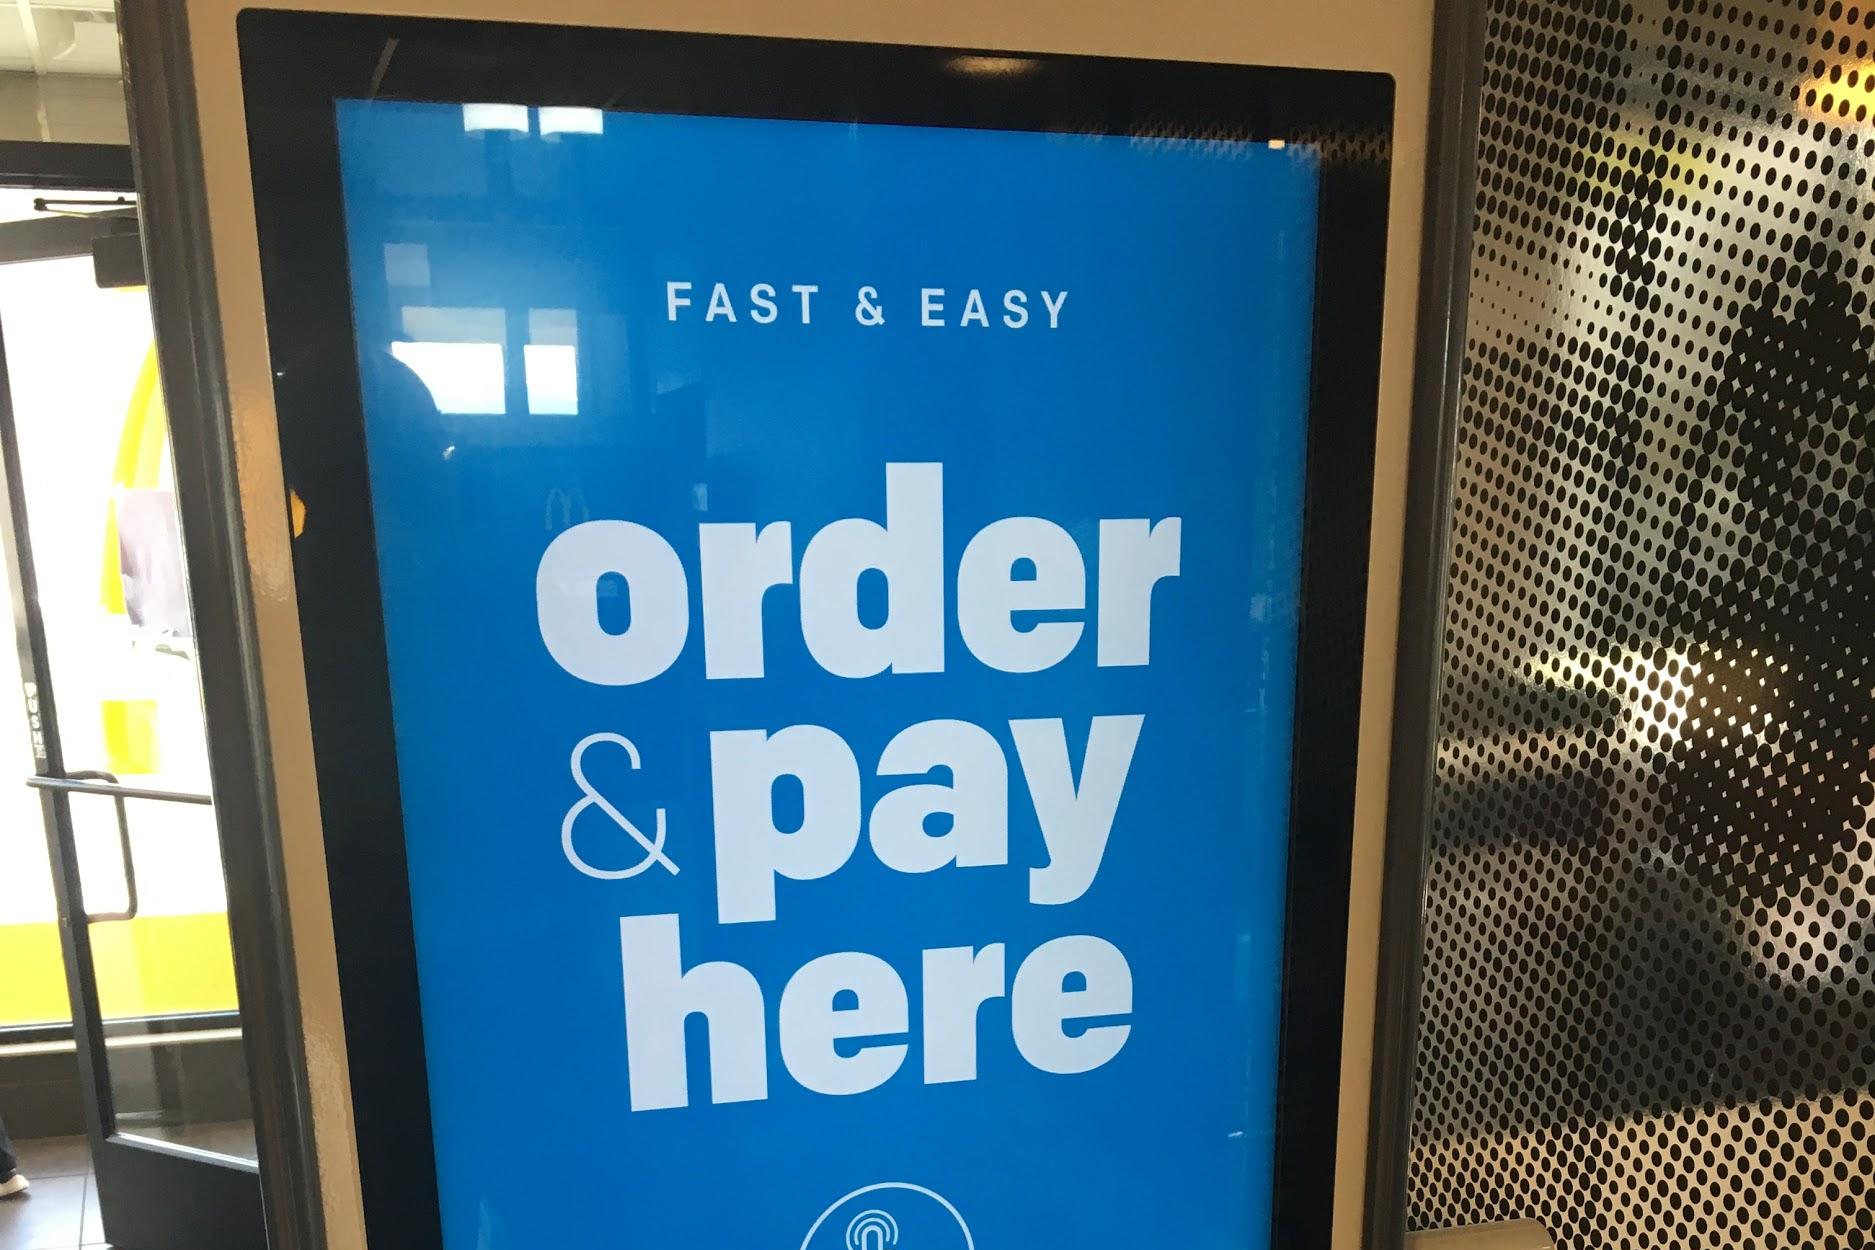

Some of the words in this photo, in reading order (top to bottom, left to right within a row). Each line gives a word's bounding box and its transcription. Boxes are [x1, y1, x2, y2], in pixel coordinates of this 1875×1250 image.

[667, 282, 818, 323] FAST
[855, 286, 885, 325] &
[922, 288, 1067, 328] EASY
[536, 463, 1181, 685] order
[562, 733, 680, 879] &
[710, 715, 1145, 924] pay
[620, 914, 1132, 1111] here
